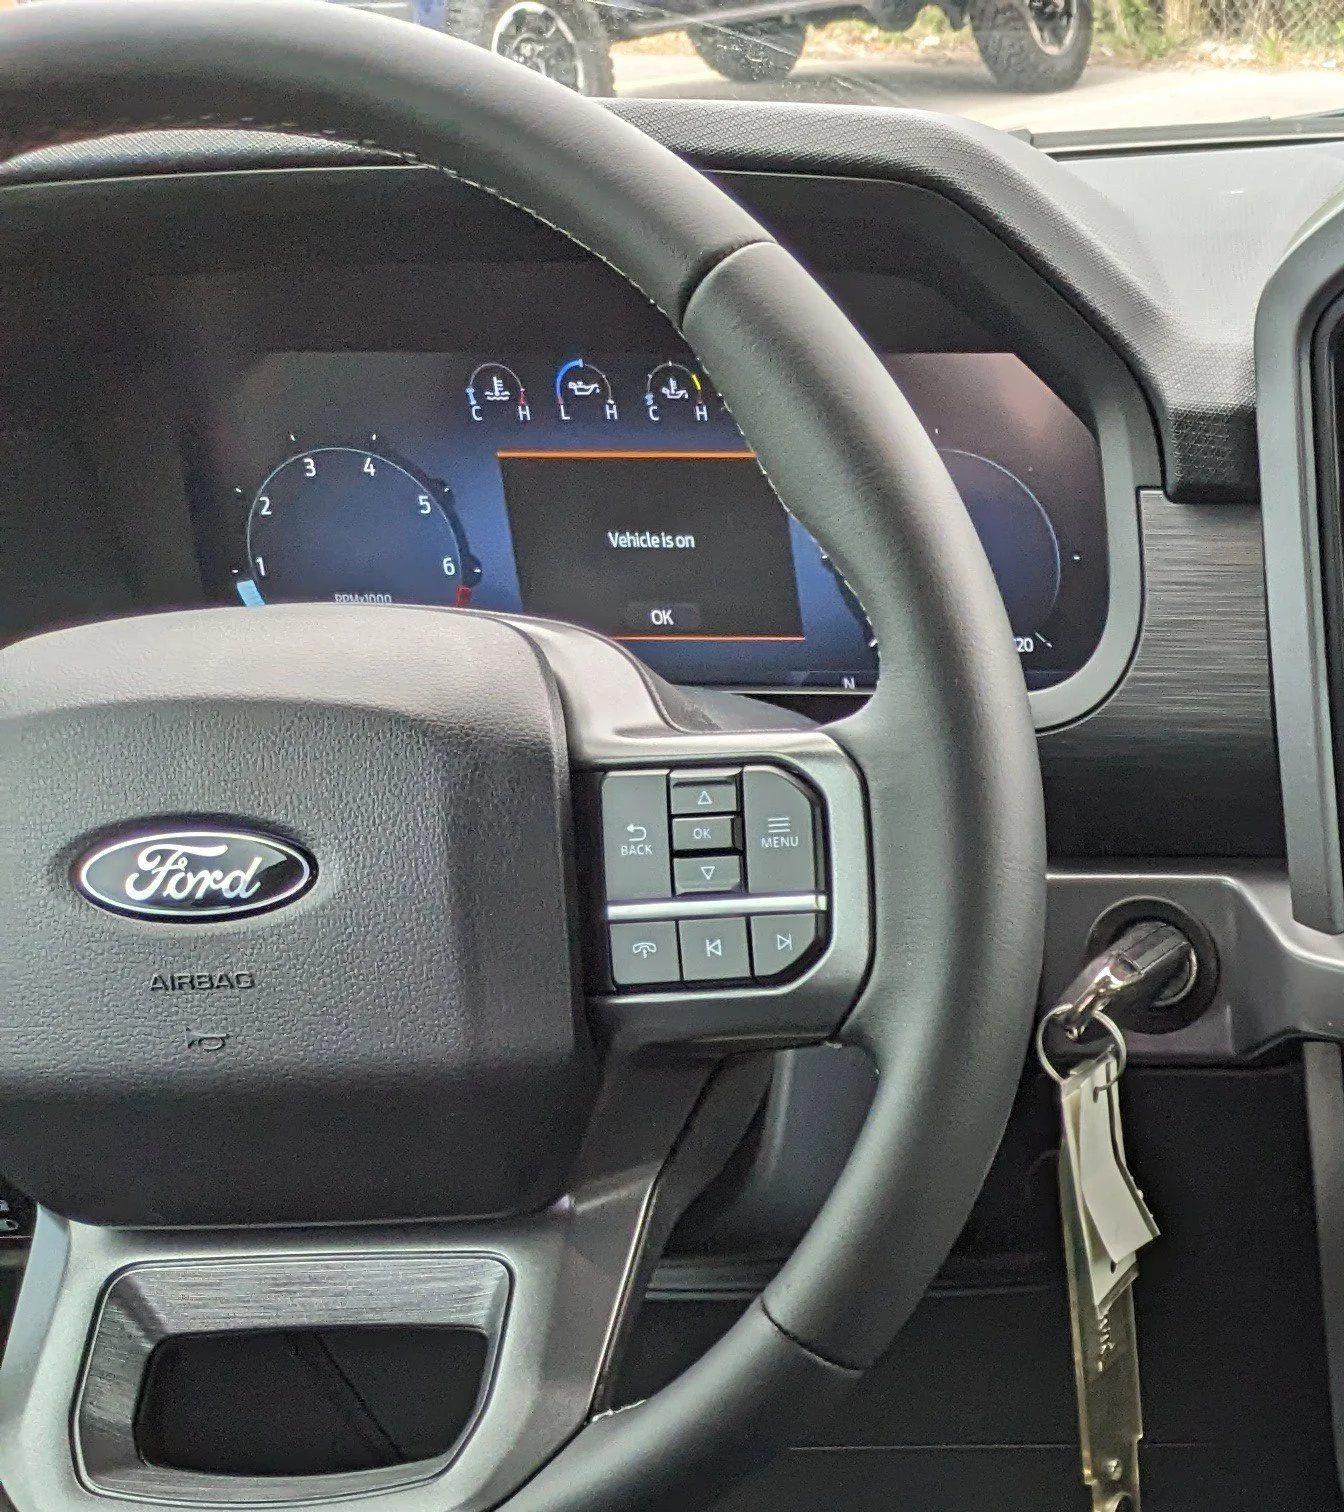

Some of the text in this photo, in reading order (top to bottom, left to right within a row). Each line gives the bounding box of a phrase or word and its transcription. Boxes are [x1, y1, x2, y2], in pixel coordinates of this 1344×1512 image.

[472, 405, 483, 421] C
[518, 405, 531, 421] H
[560, 404, 571, 420] L
[606, 404, 618, 420] H
[649, 405, 660, 421] C
[695, 405, 708, 422] H
[303, 458, 317, 477] 3
[363, 457, 376, 477] 4
[259, 496, 272, 516] 2
[418, 495, 432, 514] 5
[607, 531, 695, 548] Vehicle is on
[255, 556, 266, 576] 1
[442, 557, 456, 576] 6
[650, 609, 674, 625] OK
[843, 677, 856, 689] N
[693, 828, 712, 839] OK
[761, 835, 799, 848] MENU
[620, 844, 653, 856] BACK
[125, 844, 263, 901] Ford
[150, 971, 256, 992] AIRBAG
